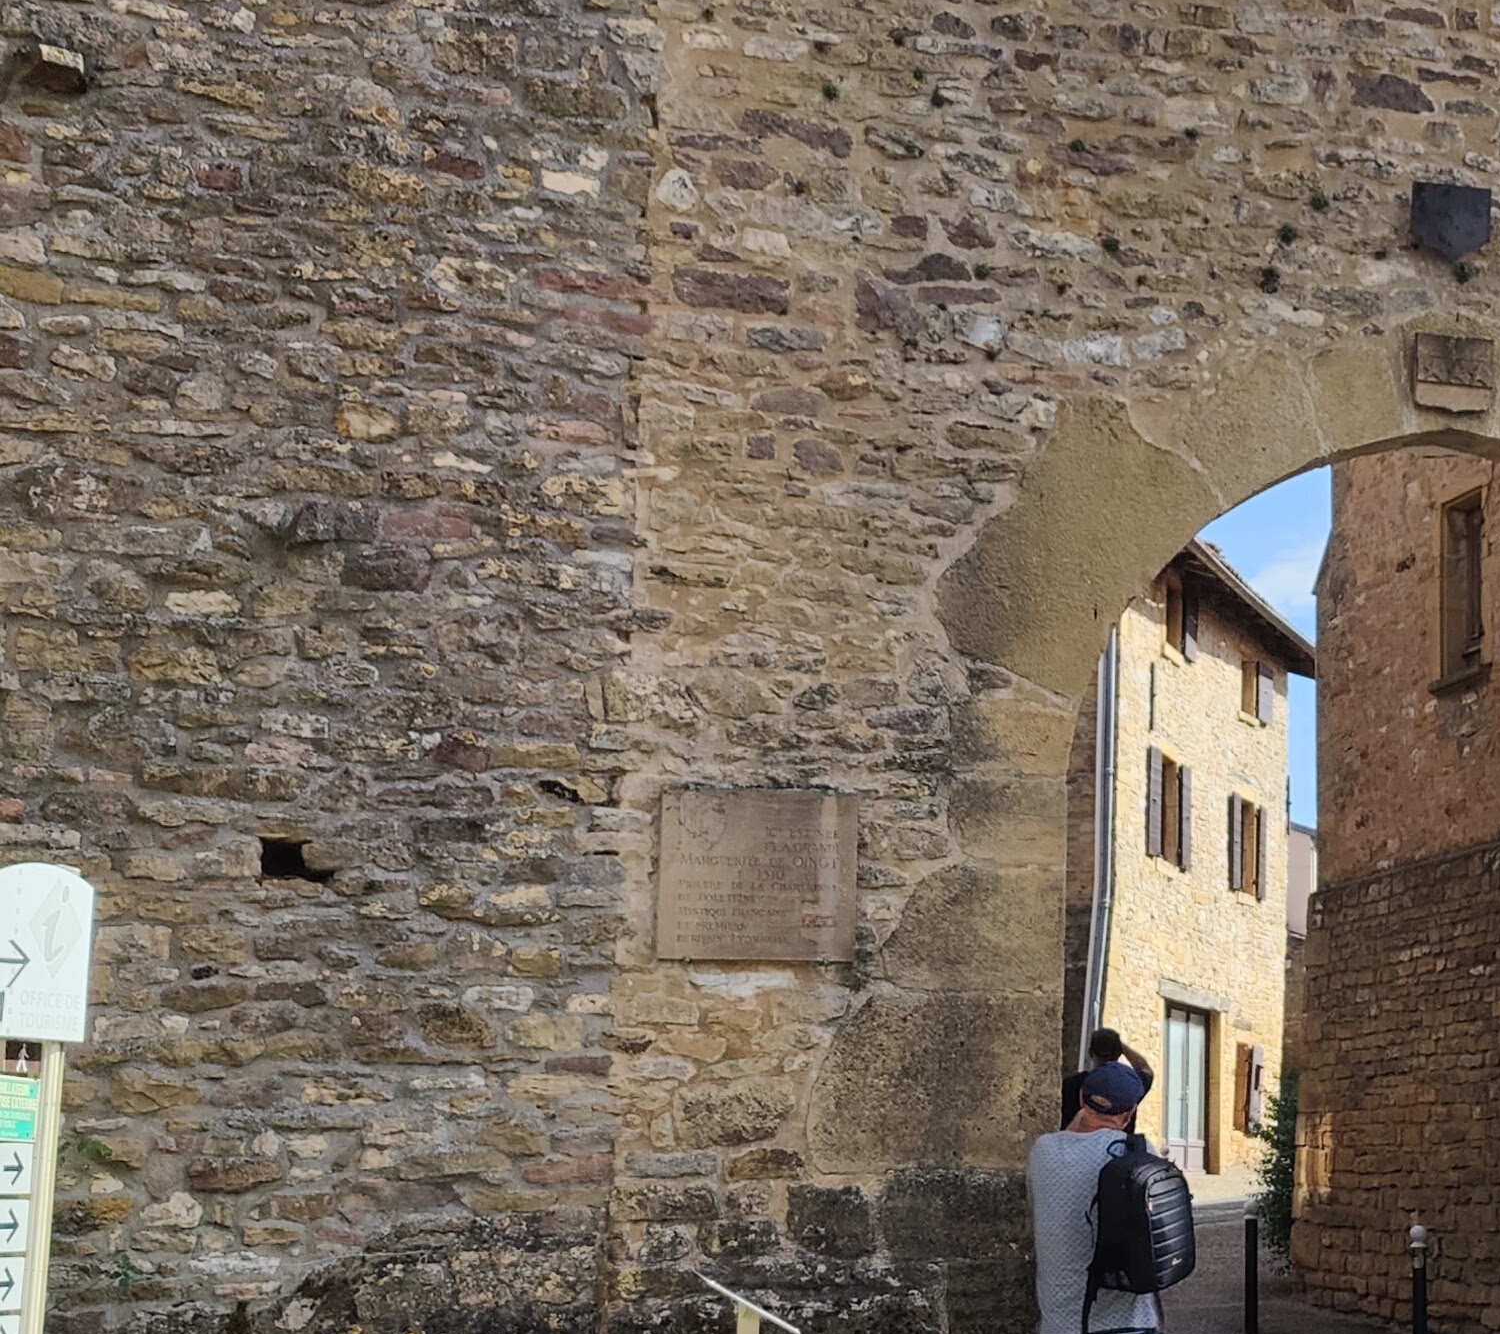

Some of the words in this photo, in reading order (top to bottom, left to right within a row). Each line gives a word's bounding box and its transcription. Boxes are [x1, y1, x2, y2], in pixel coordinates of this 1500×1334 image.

[680, 852, 761, 867] MARGUERITE
[769, 857, 785, 867] DE
[792, 855, 840, 869] OINGT
[19, 989, 62, 1009] OFFICE
[65, 994, 81, 1011] DE
[18, 1011, 79, 1032] TOURISME
